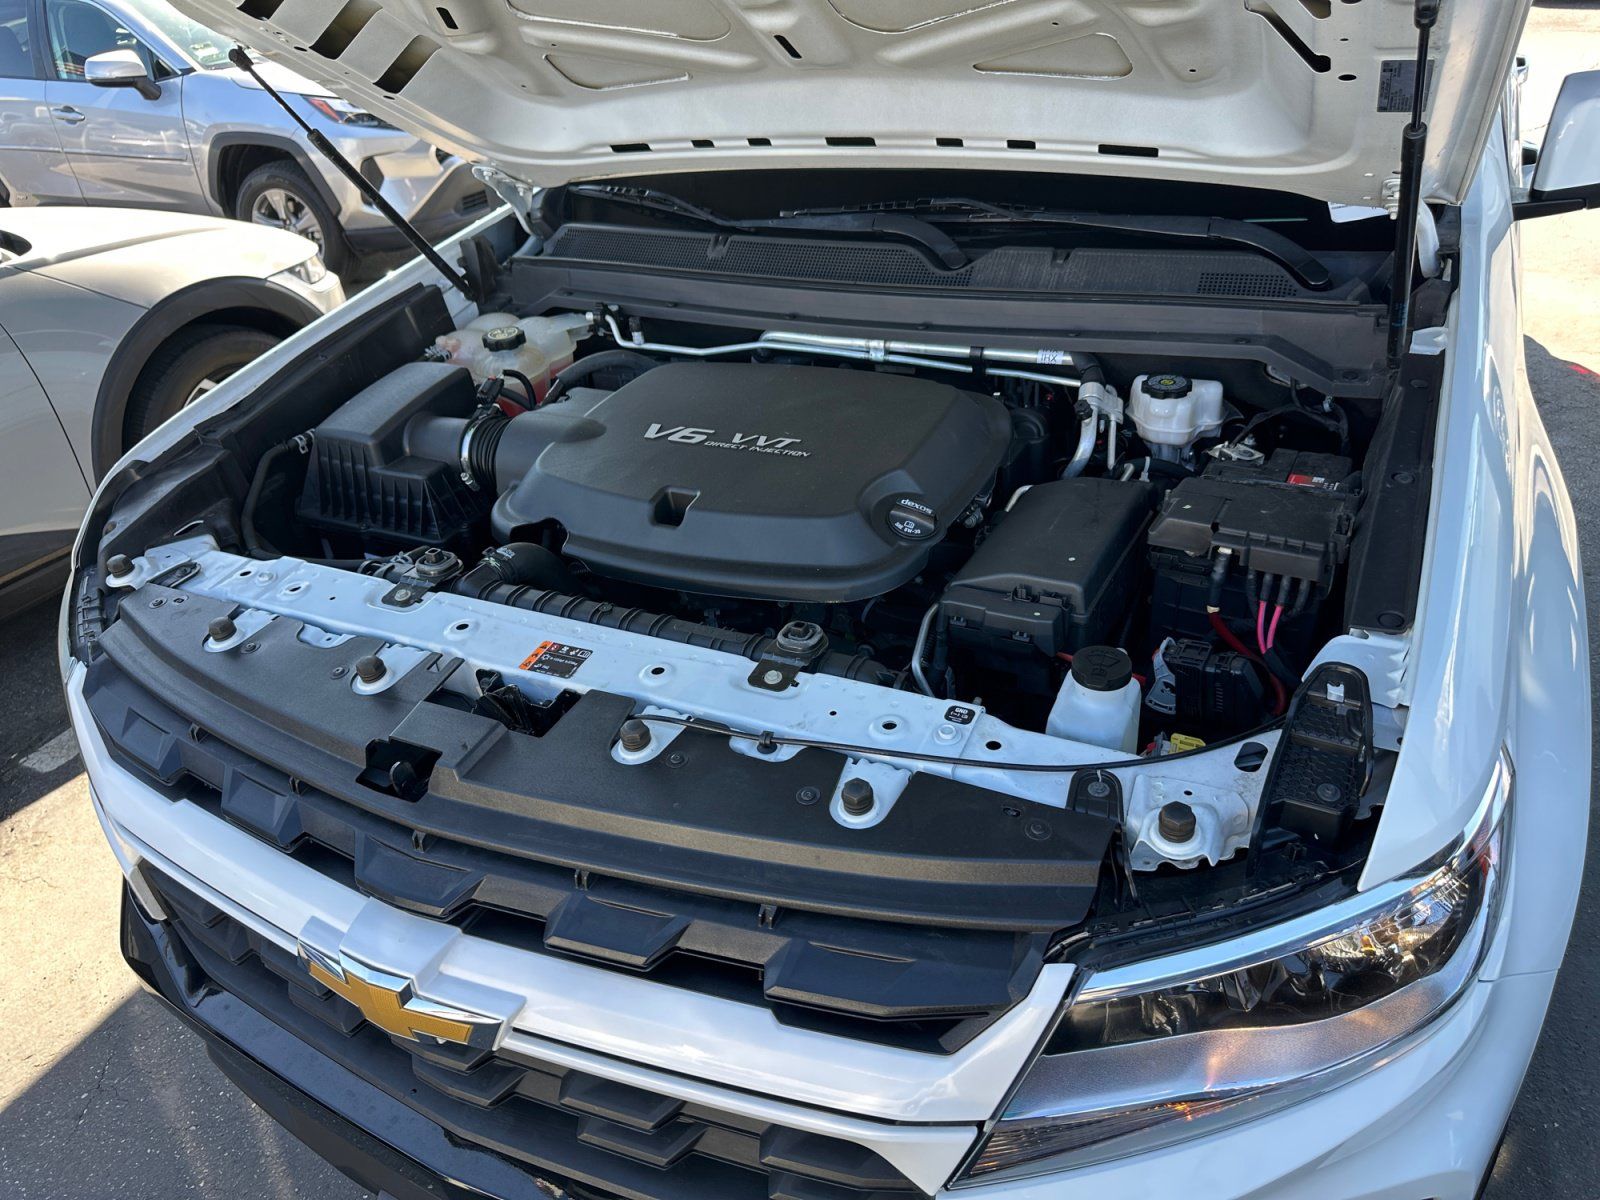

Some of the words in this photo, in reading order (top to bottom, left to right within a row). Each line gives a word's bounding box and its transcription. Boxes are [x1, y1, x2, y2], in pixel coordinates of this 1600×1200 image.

[644, 423, 715, 444] V6
[732, 432, 801, 449] VVT
[704, 440, 748, 450] DIRECT
[749, 446, 811, 457] INJECTION
[901, 499, 933, 514] dexos
